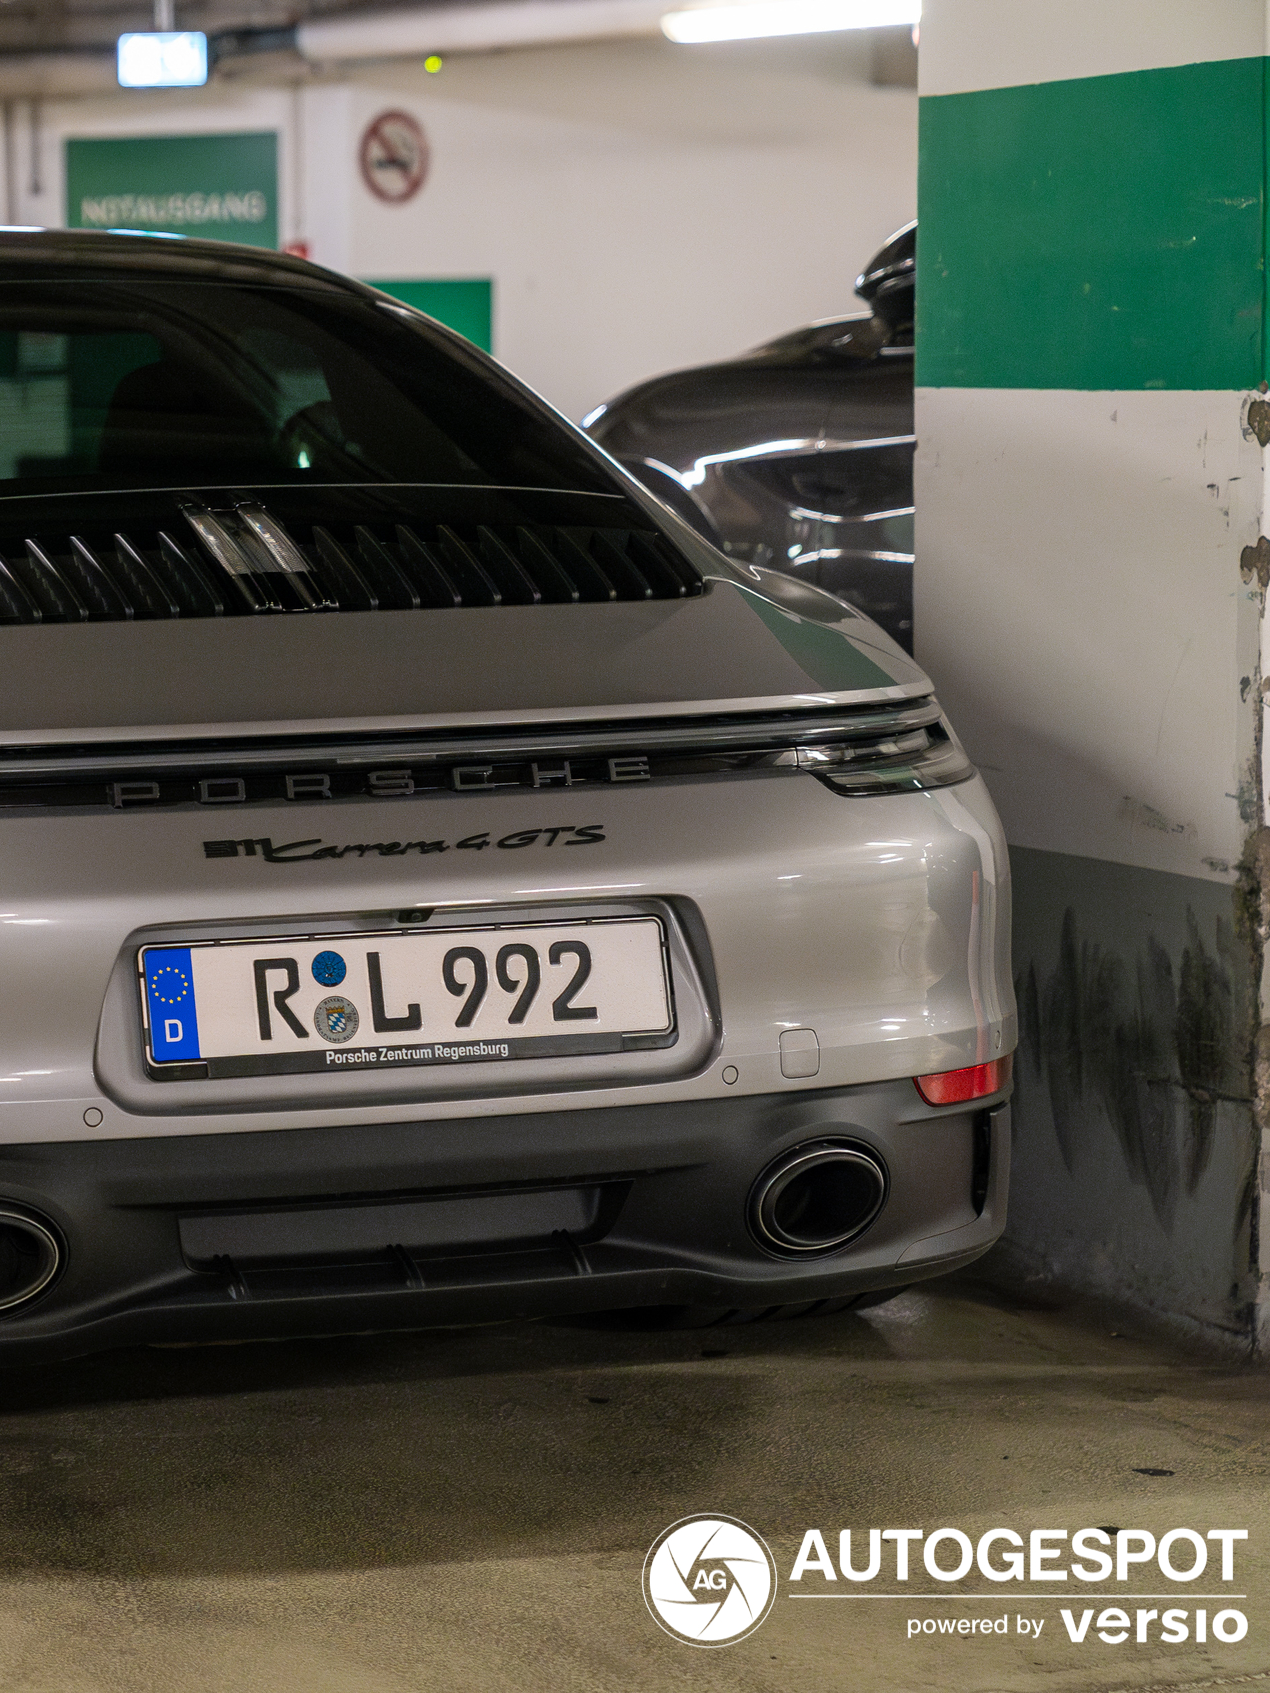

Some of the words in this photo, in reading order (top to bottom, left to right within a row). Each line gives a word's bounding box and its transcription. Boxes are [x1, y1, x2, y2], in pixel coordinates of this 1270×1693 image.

[81, 191, 267, 225] NOTAUSGANG
[109, 756, 651, 808] PORSCHE
[264, 838, 450, 863] Carrera
[455, 832, 490, 850] 4
[496, 824, 607, 849] GTS
[252, 957, 309, 1041] R
[366, 951, 422, 1034] L
[442, 940, 600, 1028] 992
[164, 1019, 183, 1043] D
[325, 1049, 377, 1065] Porsche
[379, 1047, 432, 1061] Zentrum
[435, 1042, 509, 1060] Regensburg
